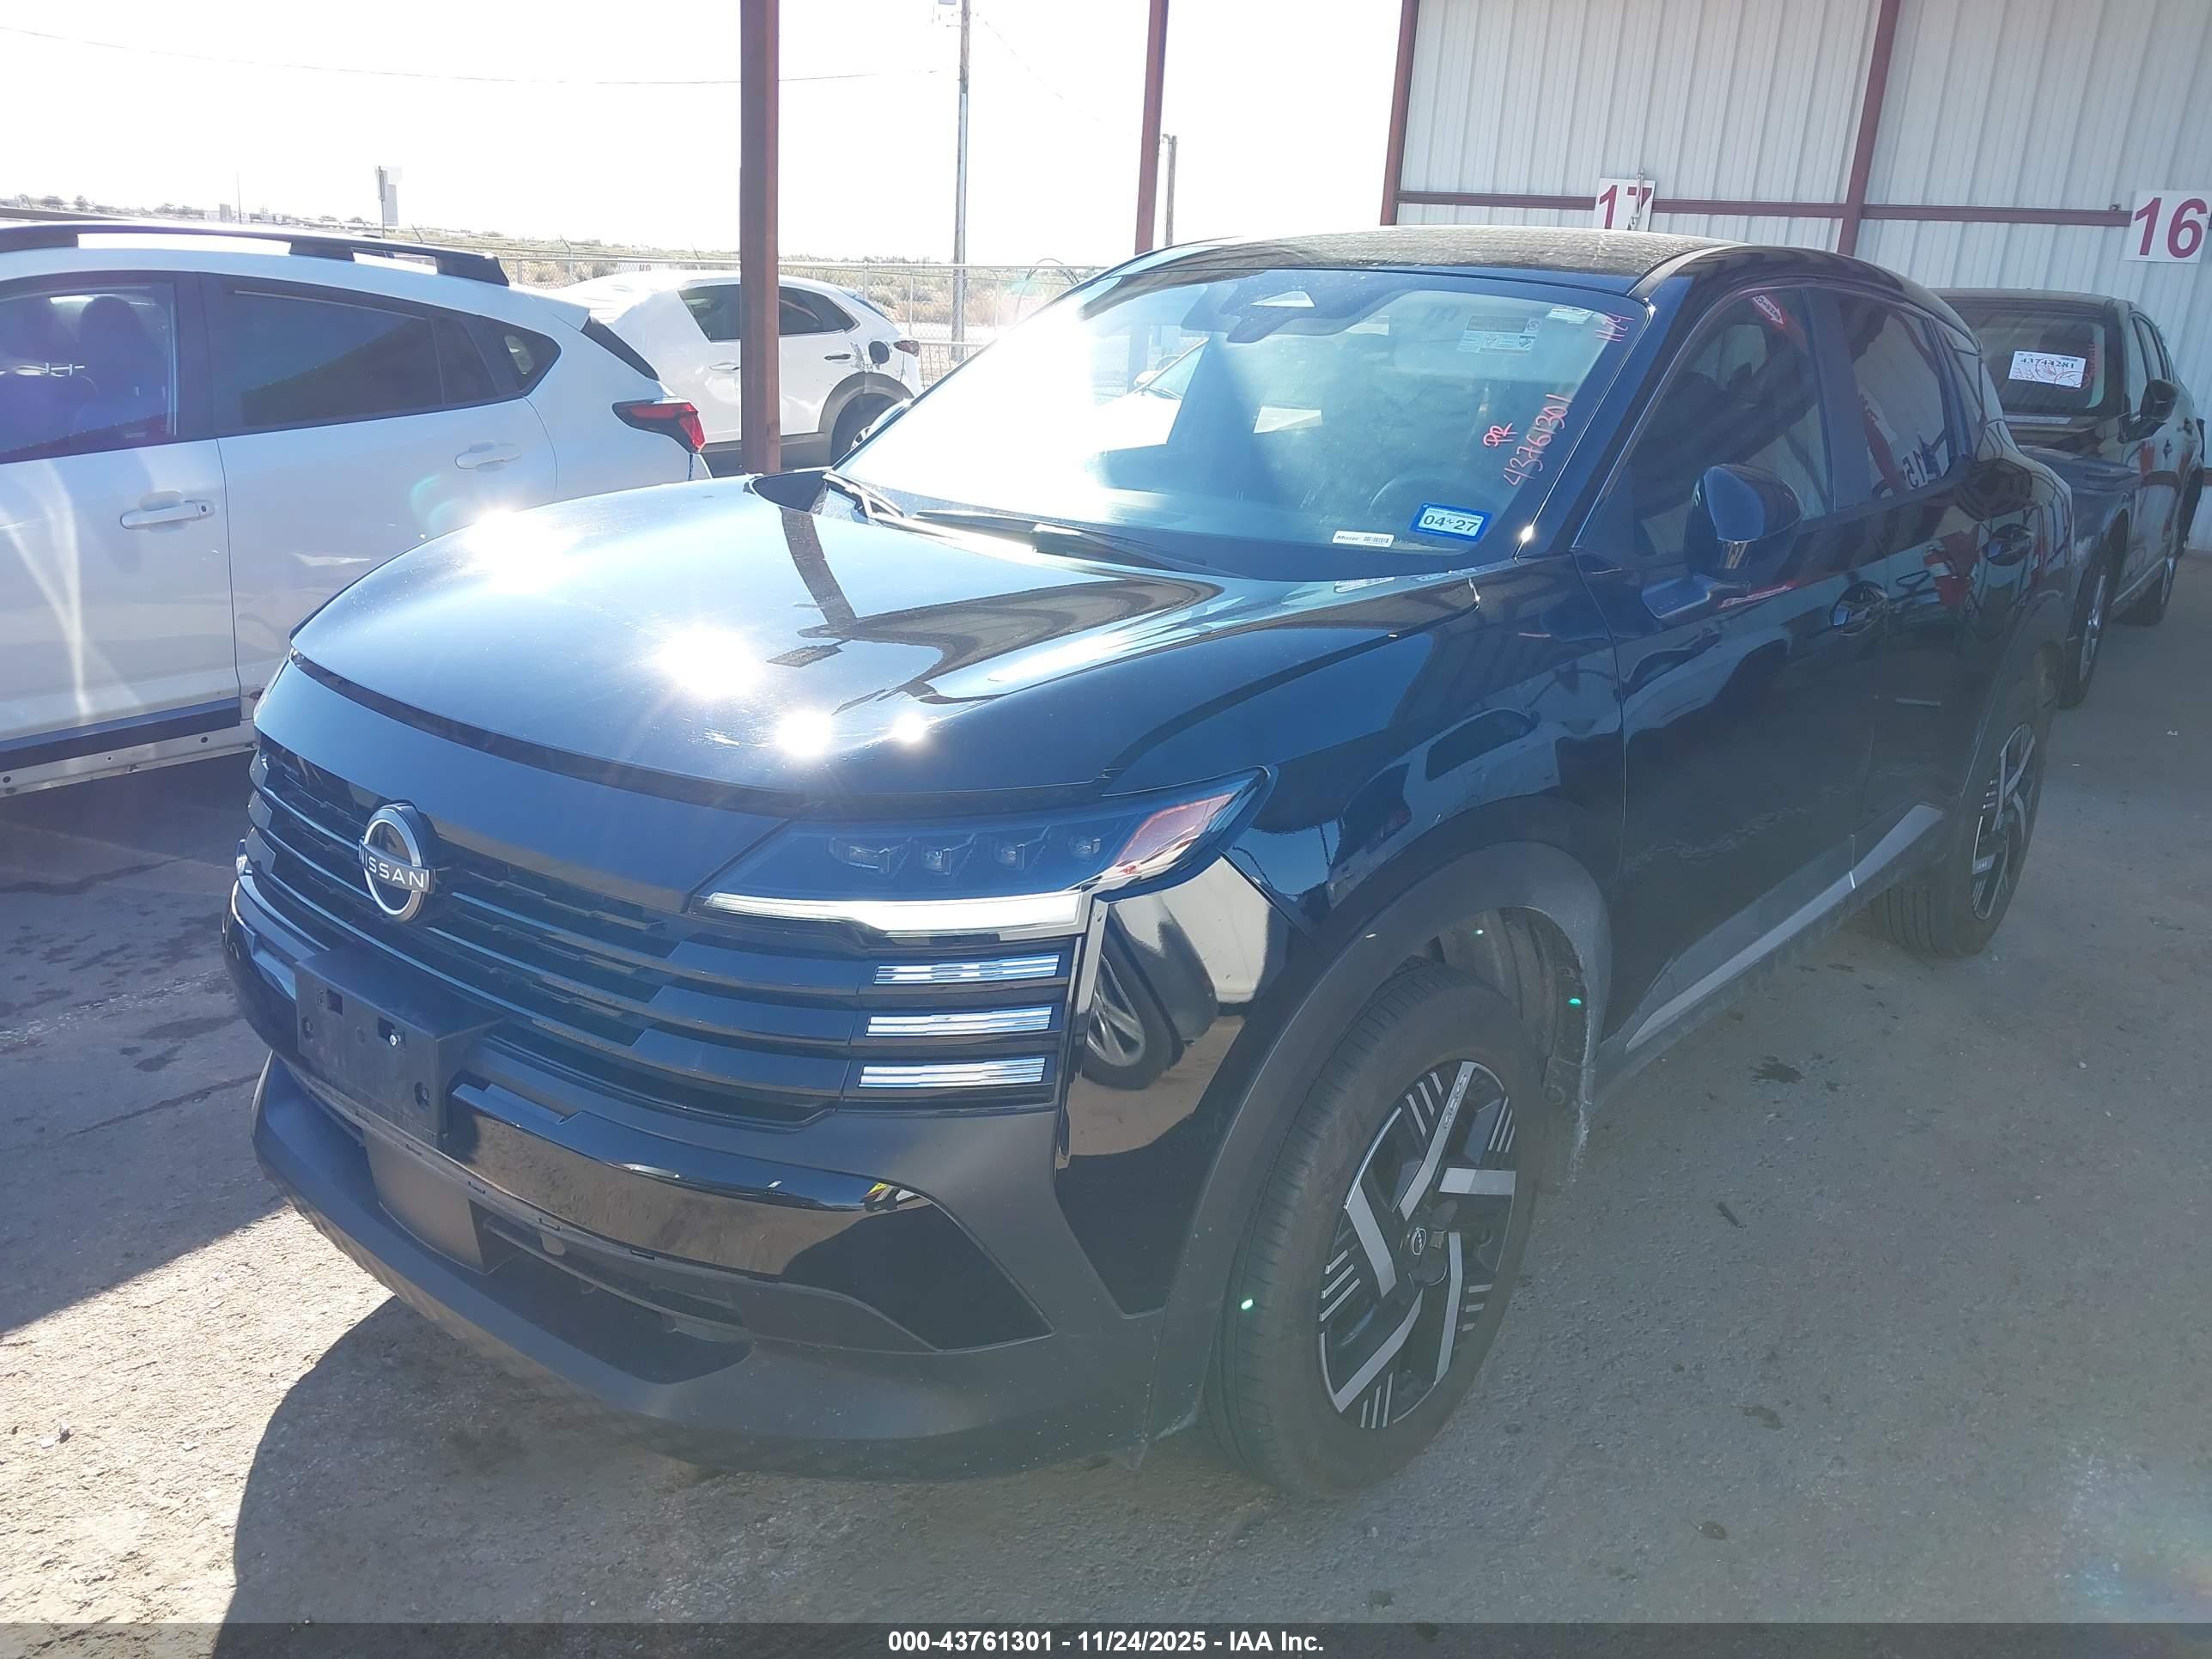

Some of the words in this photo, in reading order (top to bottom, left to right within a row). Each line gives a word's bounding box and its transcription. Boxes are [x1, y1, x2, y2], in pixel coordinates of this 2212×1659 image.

[2135, 197, 2208, 258] 16
[1503, 393, 1574, 486] 43761301
[1424, 515, 1445, 526] 04
[1453, 520, 1478, 532] 27
[358, 843, 424, 889] NISSAN
